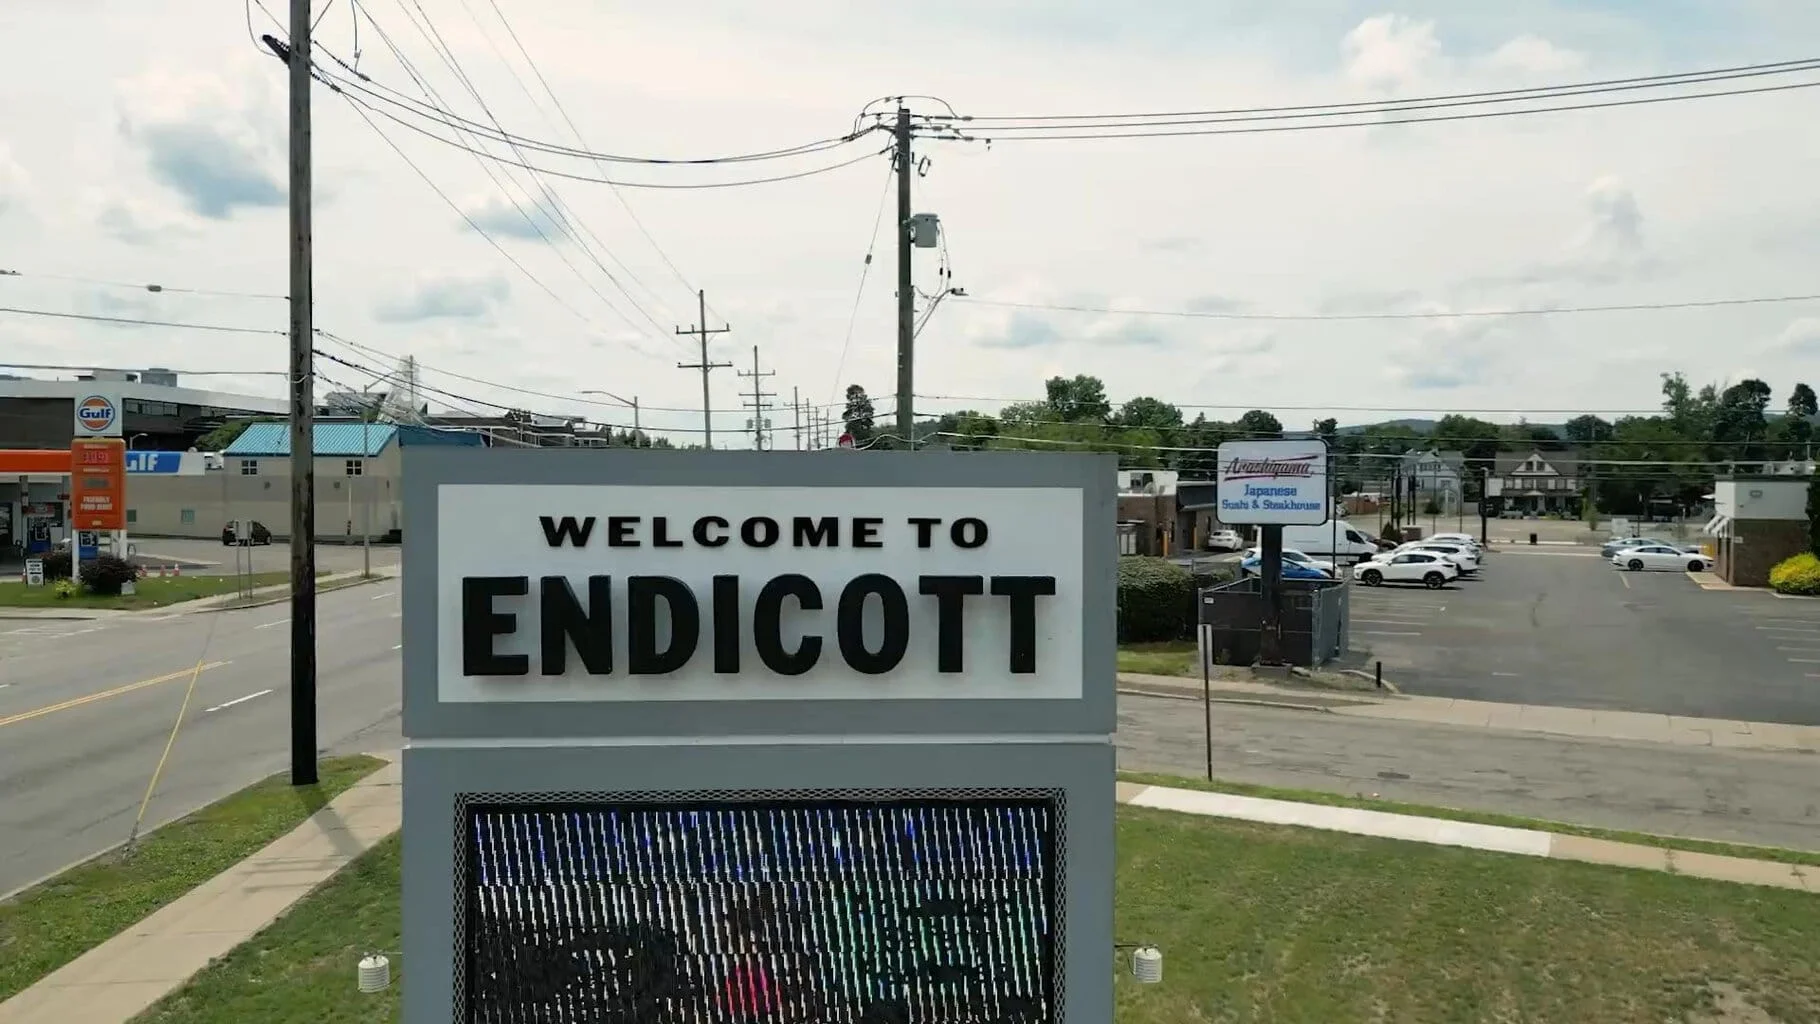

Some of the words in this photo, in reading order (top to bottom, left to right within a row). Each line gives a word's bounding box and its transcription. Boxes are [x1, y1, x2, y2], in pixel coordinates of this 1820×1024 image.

[79, 408, 112, 419] Gulf
[1225, 456, 1311, 479] Arashiyama
[1244, 484, 1297, 498] Japanese
[1222, 499, 1249, 510] Sushi
[1251, 500, 1260, 510] &
[1263, 500, 1321, 511] Steakhouse
[539, 516, 884, 548] WELCOME
[907, 517, 990, 548] TO
[462, 573, 1057, 676] ENDICOTT
